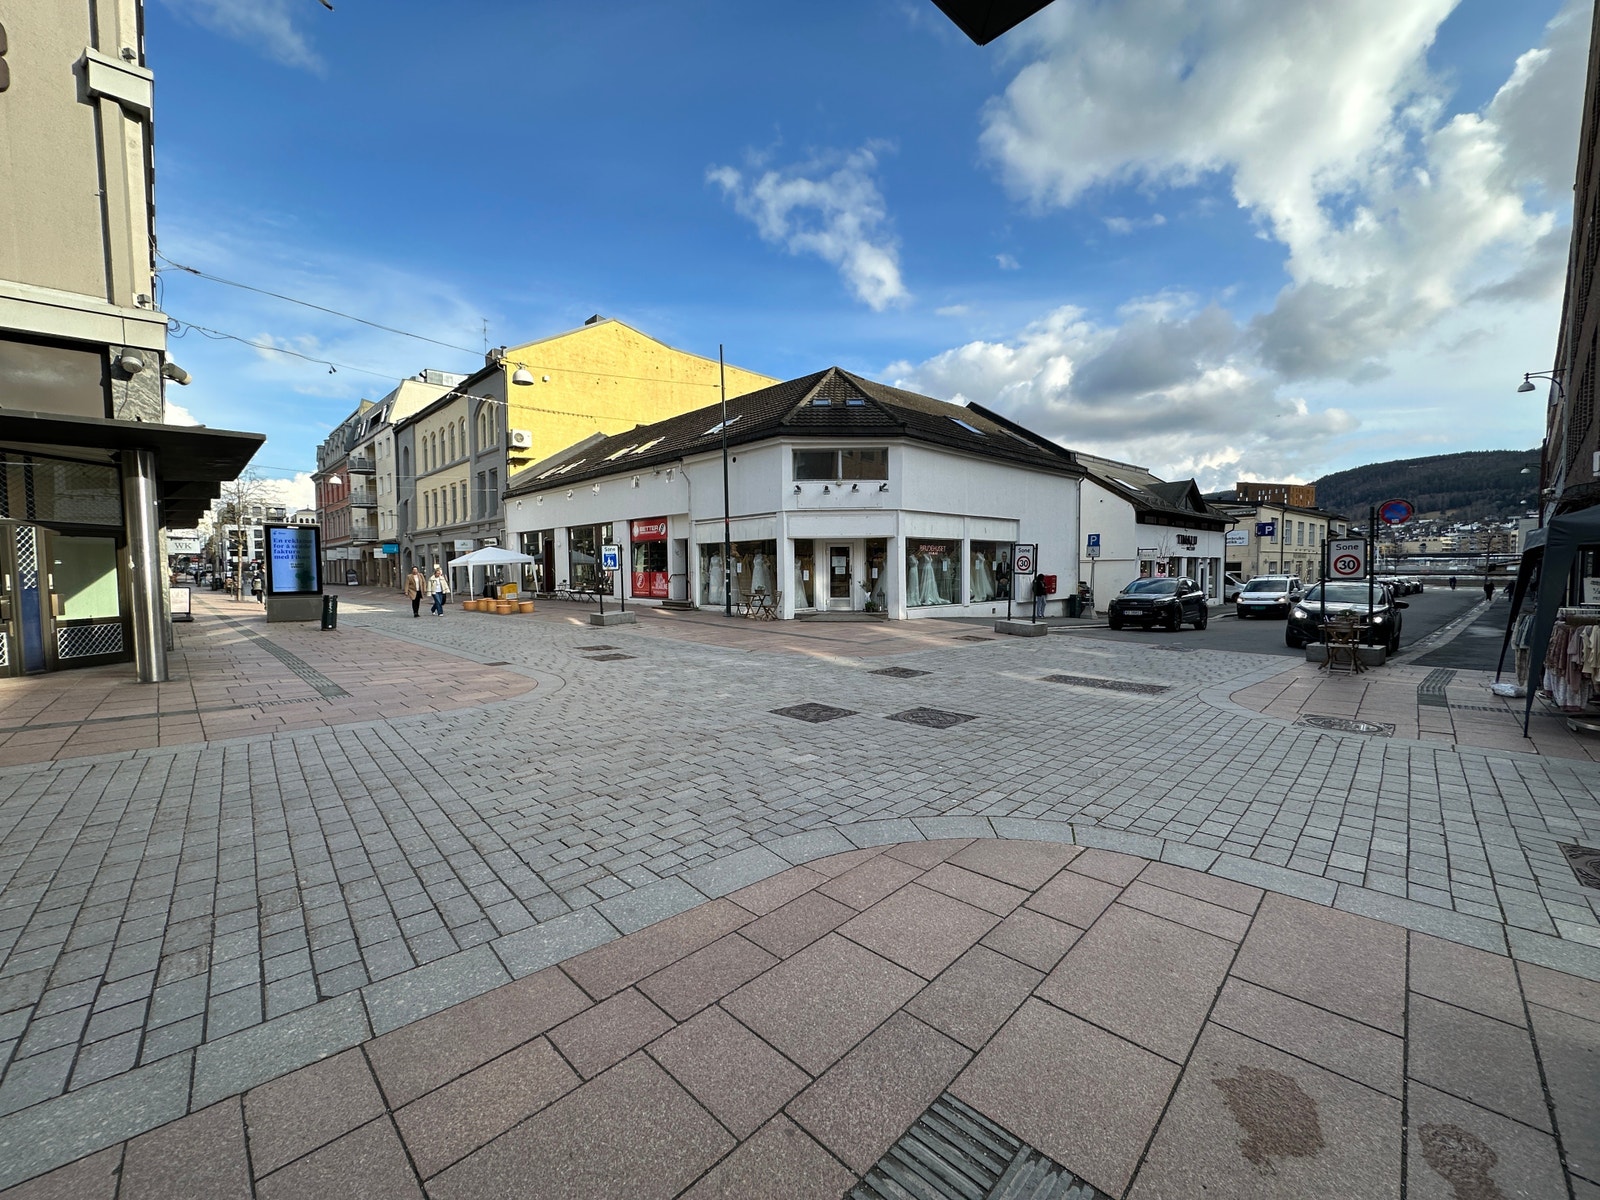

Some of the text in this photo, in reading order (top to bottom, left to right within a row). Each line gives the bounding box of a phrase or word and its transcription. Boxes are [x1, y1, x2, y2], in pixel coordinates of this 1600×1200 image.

[1265, 525, 1273, 535] P
[1090, 535, 1098, 546] P
[1335, 543, 1359, 551] Sone
[1019, 559, 1029, 567] 30
[1338, 560, 1356, 570] 30
